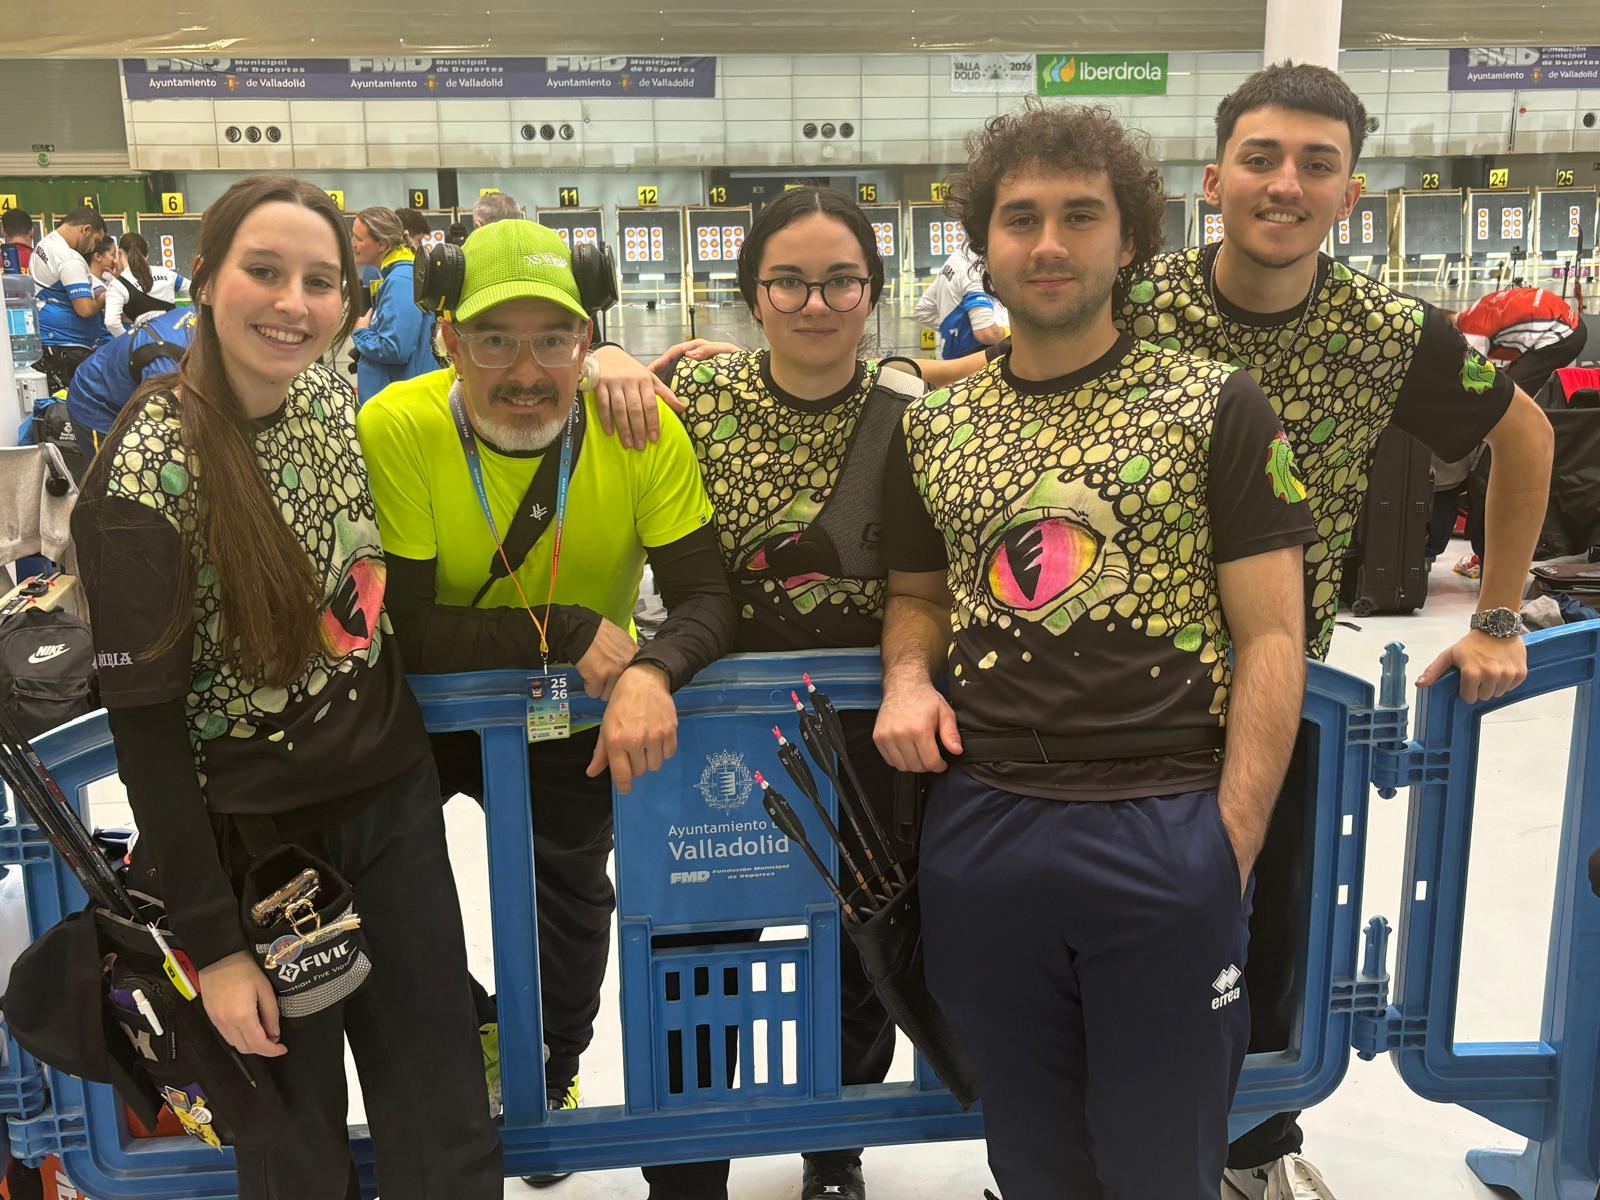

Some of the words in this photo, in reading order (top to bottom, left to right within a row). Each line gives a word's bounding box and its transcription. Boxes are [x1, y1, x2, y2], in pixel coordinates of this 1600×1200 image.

[349, 57, 432, 72] FMD
[546, 56, 627, 72] FMD
[1468, 48, 1540, 67] FMD
[954, 62, 980, 71] VALLA
[1010, 62, 1032, 71] 2026
[1080, 61, 1161, 80] Iberdrola
[954, 71, 980, 80] DOLID
[1467, 72, 1524, 82] Ayuntamiento
[149, 78, 217, 88] Ayuntamiento
[246, 78, 258, 87] de
[260, 78, 306, 88] Valladolid
[350, 79, 417, 89] Ayuntamiento
[446, 79, 457, 87] de
[459, 78, 503, 88] Valladolid
[547, 78, 612, 88] Ayuntamiento
[639, 78, 650, 87] de
[652, 78, 695, 88] Valladolid
[1423, 173, 1439, 189] 23
[1491, 172, 1506, 186] 24
[1557, 170, 1574, 185] 25
[414, 191, 424, 207] 9
[561, 189, 578, 205] 11
[640, 188, 657, 204] 12
[709, 187, 727, 203] 13
[859, 186, 876, 200] 15
[84, 196, 94, 209] 5
[168, 196, 178, 211] 6
[922, 332, 935, 342] 14
[36, 643, 66, 657] NIKE
[551, 677, 567, 688] 25
[551, 689, 568, 700] 26
[668, 820, 767, 838] Ayuntamiento
[669, 834, 789, 861] Valladolid
[670, 870, 710, 884] FMD
[754, 863, 790, 871] Municipal
[313, 970, 331, 981] FIVE
[1211, 986, 1241, 1010] errea
